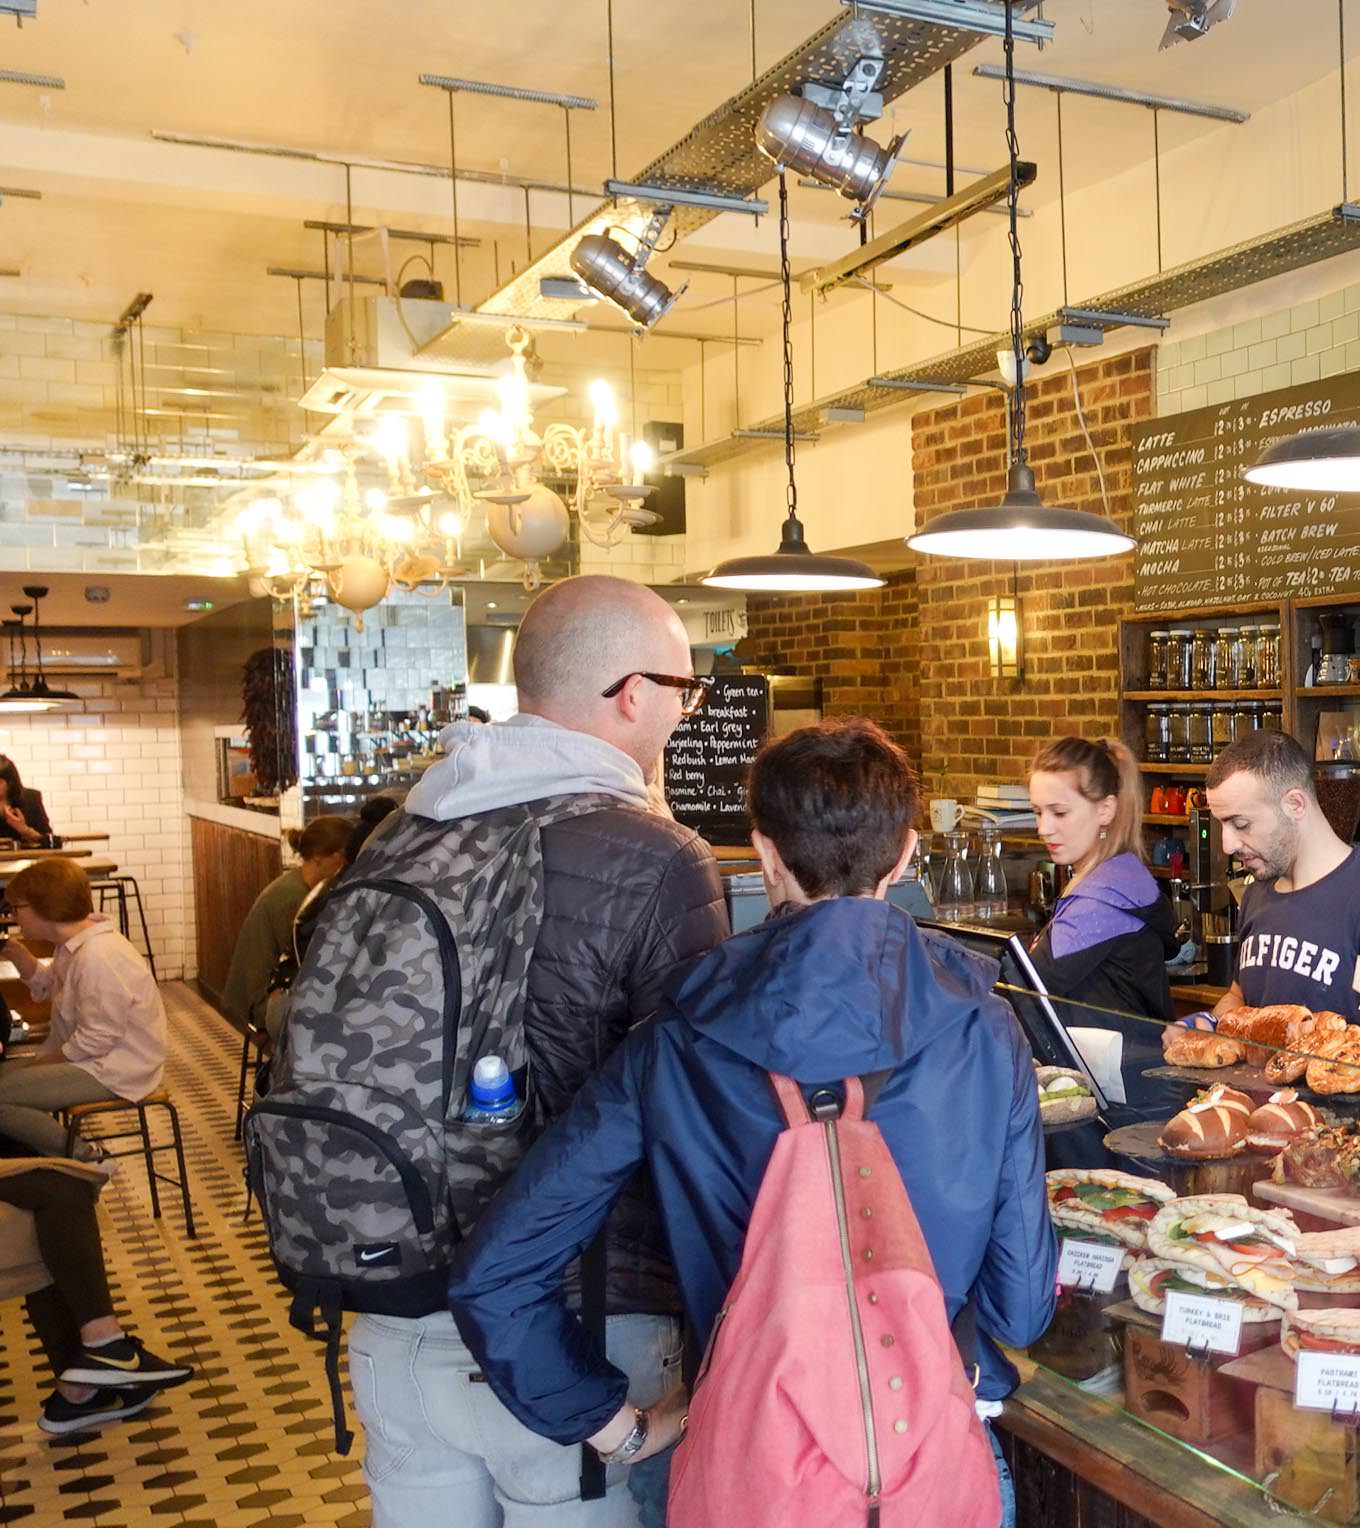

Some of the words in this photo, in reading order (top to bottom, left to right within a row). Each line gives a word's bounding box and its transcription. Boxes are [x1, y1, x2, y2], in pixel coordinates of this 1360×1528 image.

[1259, 399, 1332, 429] ESPRESSO
[1138, 432, 1175, 452] LATTE
[1136, 449, 1205, 474] CAPPUCCINO
[1138, 483, 1163, 497] FLAT
[1169, 472, 1206, 488] WHITE
[1138, 500, 1183, 514] TURMERIC
[1260, 503, 1300, 520] FILTER
[1139, 521, 1163, 535] CHAI
[1168, 517, 1197, 529] LATTE
[1260, 527, 1295, 544] BATCH
[1302, 523, 1338, 537] BREW
[1140, 540, 1179, 555] MATCHA
[1140, 561, 1180, 576] MOCHA
[703, 608, 735, 639] TOILETS
[723, 684, 745, 702] Green
[708, 705, 748, 719] breakfast
[701, 721, 718, 732] Earl
[710, 737, 758, 754] Peppermint
[672, 755, 706, 765] Redbush
[715, 755, 737, 766] Lemon
[686, 771, 705, 788] berry
[707, 786, 726, 796] Chai
